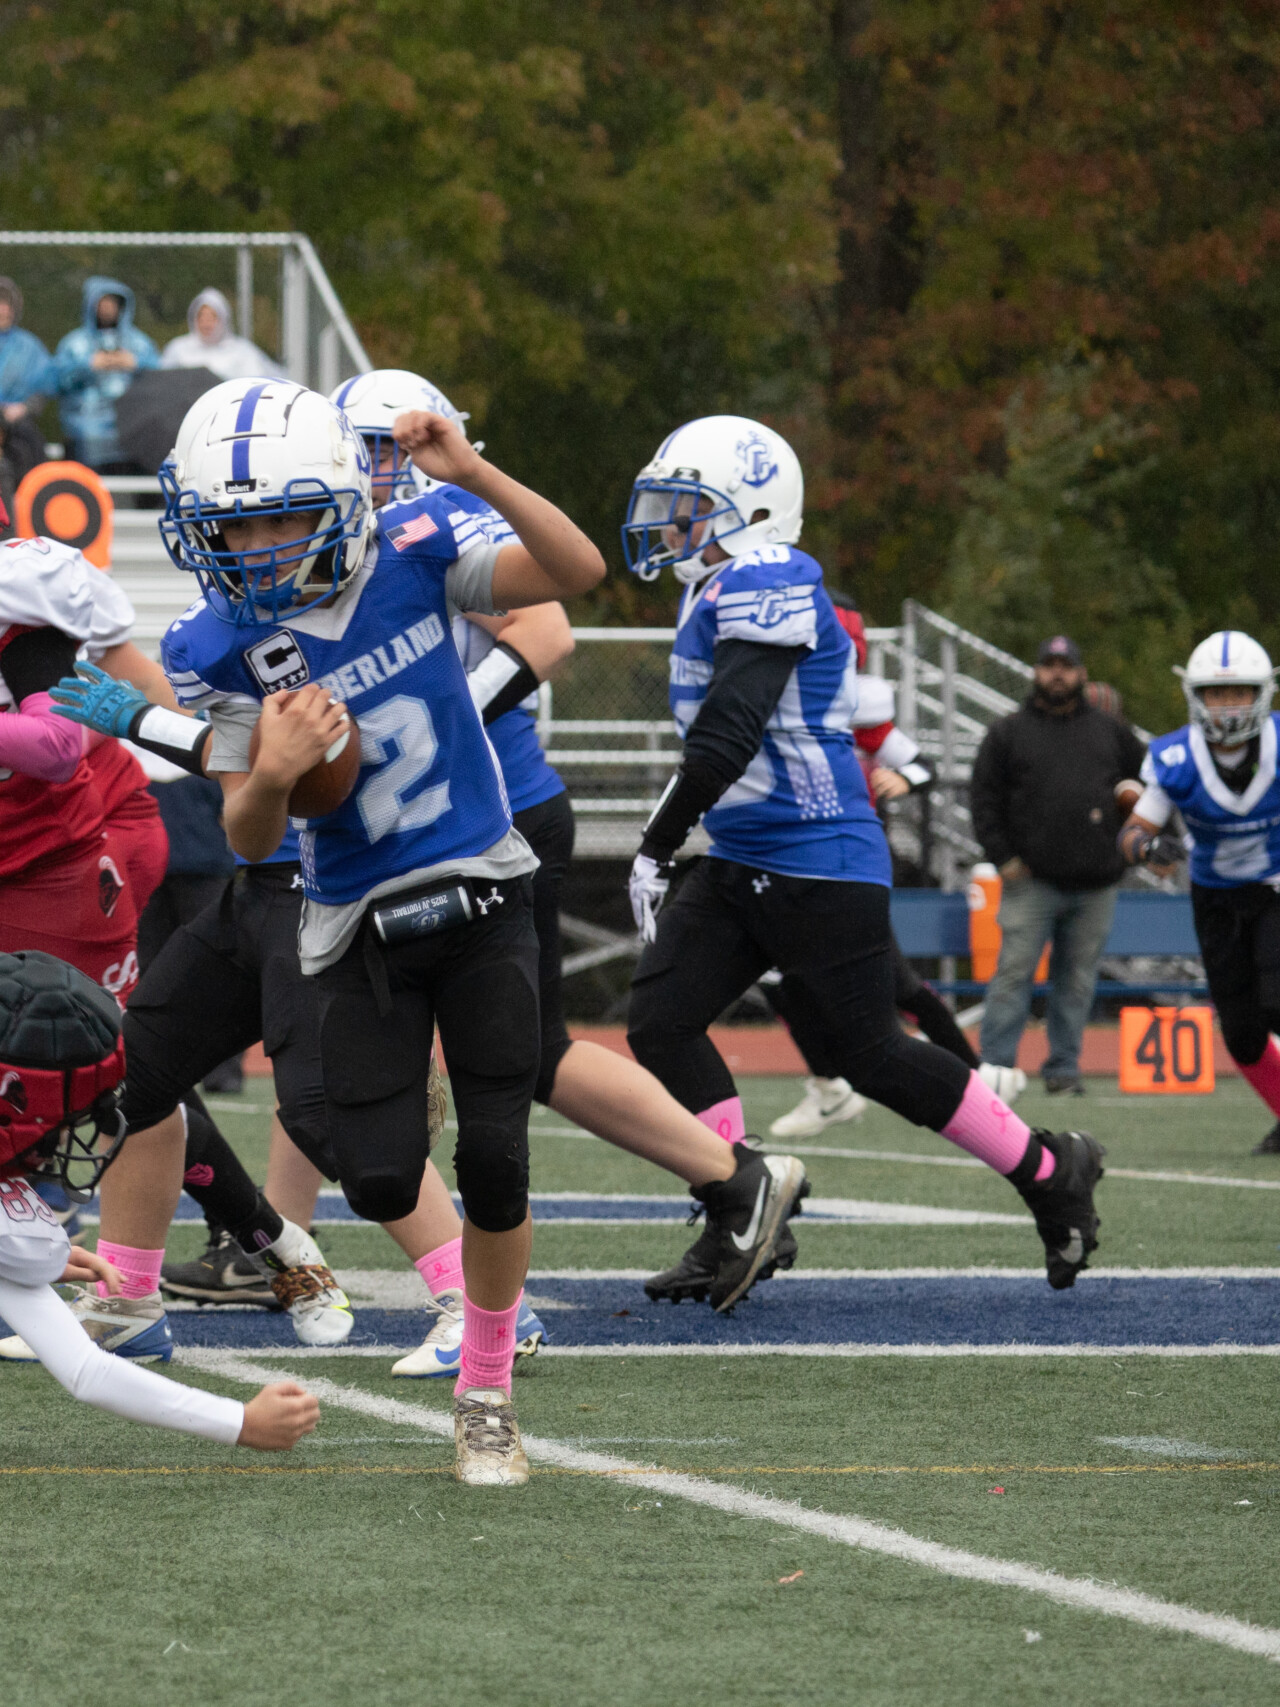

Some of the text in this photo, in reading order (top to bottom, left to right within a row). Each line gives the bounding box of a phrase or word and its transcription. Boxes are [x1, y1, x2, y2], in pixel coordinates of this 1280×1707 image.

[250, 634, 303, 684] C
[317, 612, 445, 701] BERLAND
[356, 694, 453, 845] 2
[391, 902, 422, 919] FOOTBALL
[1135, 1015, 1202, 1084] 40
